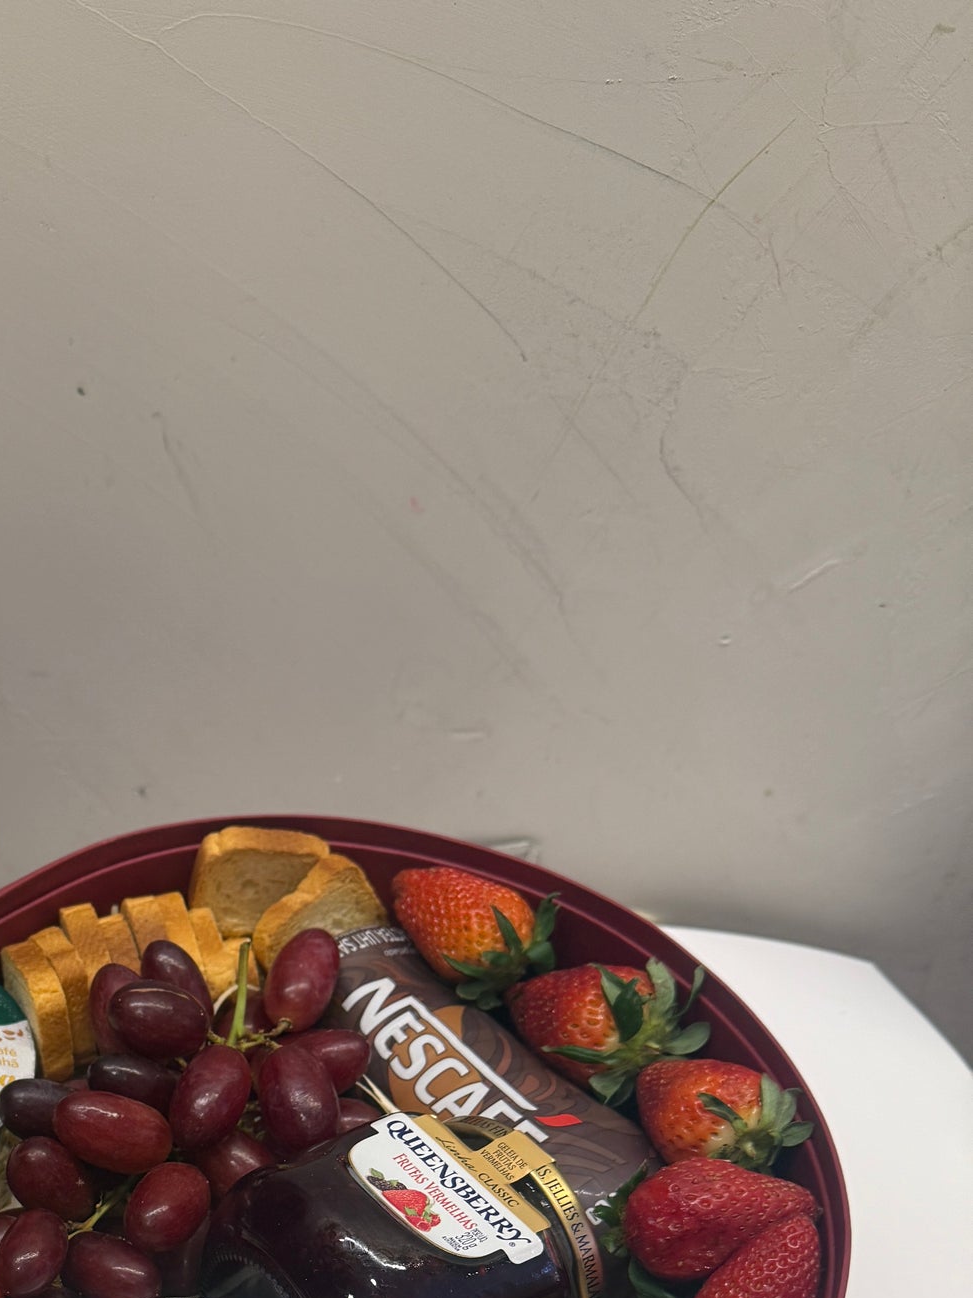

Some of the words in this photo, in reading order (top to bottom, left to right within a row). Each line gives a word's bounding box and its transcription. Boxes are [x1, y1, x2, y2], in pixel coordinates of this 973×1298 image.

[387, 1120, 531, 1244] QUEENSBERRY
[435, 1136, 477, 1173] Linha
[478, 1172, 519, 1208] CLASSIC
[480, 1149, 515, 1181] VERMELHAS
[493, 1149, 515, 1171] FRUTAS
[497, 1142, 517, 1162] GELEIA
[516, 1158, 529, 1170] DE
[393, 1153, 429, 1185] FRUTAS
[424, 1181, 477, 1230] VERMELHAS
[544, 1178, 579, 1221] JELLIES
[571, 1222, 584, 1233] &
